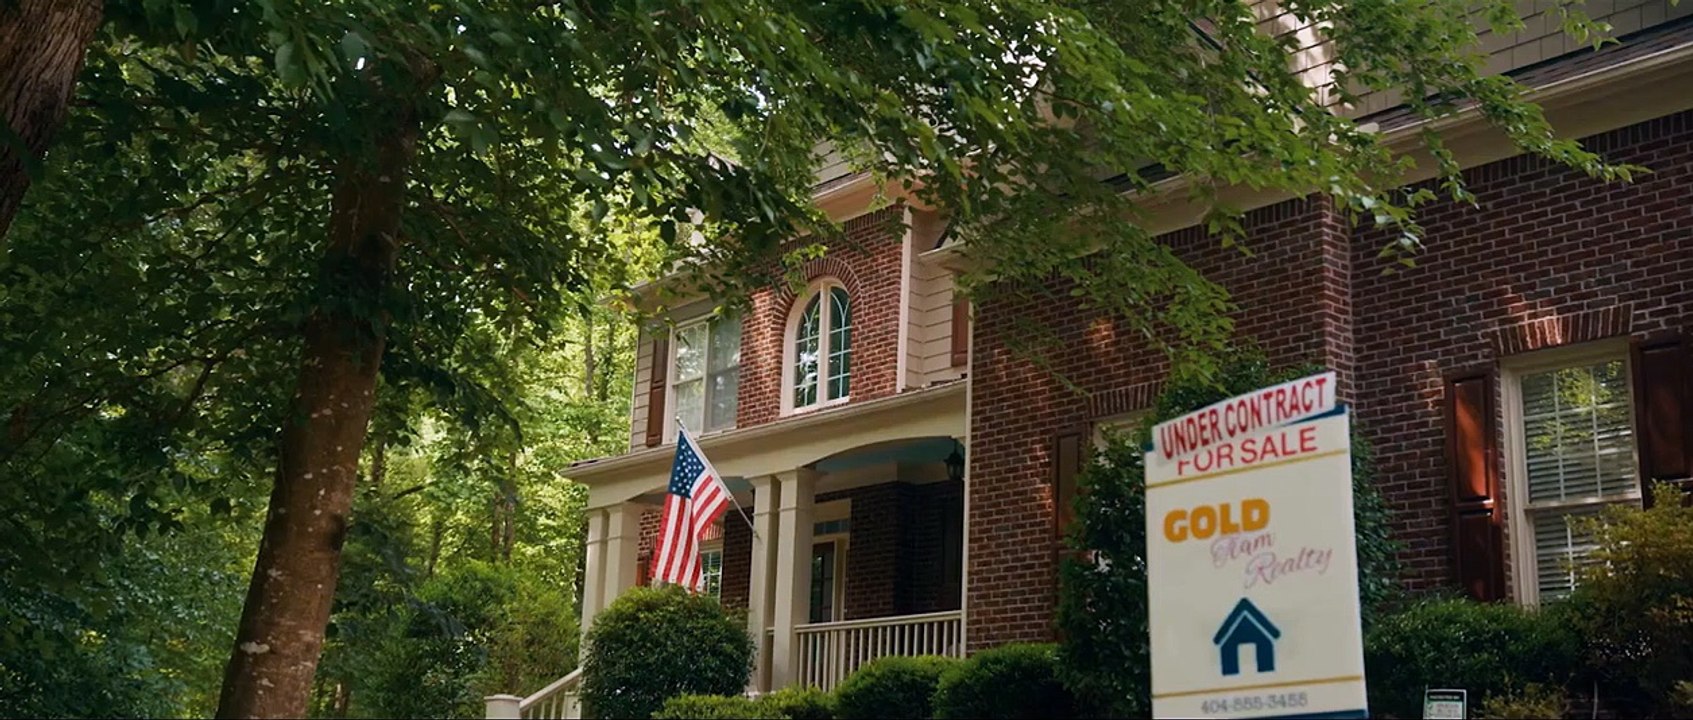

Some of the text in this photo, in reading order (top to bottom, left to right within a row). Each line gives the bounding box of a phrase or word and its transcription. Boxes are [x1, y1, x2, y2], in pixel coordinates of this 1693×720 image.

[1161, 377, 1327, 460] UNDER CONTRACT
[1240, 426, 1318, 464] SALE
[1163, 498, 1270, 543] GOLD
[1243, 547, 1333, 589] Realty
